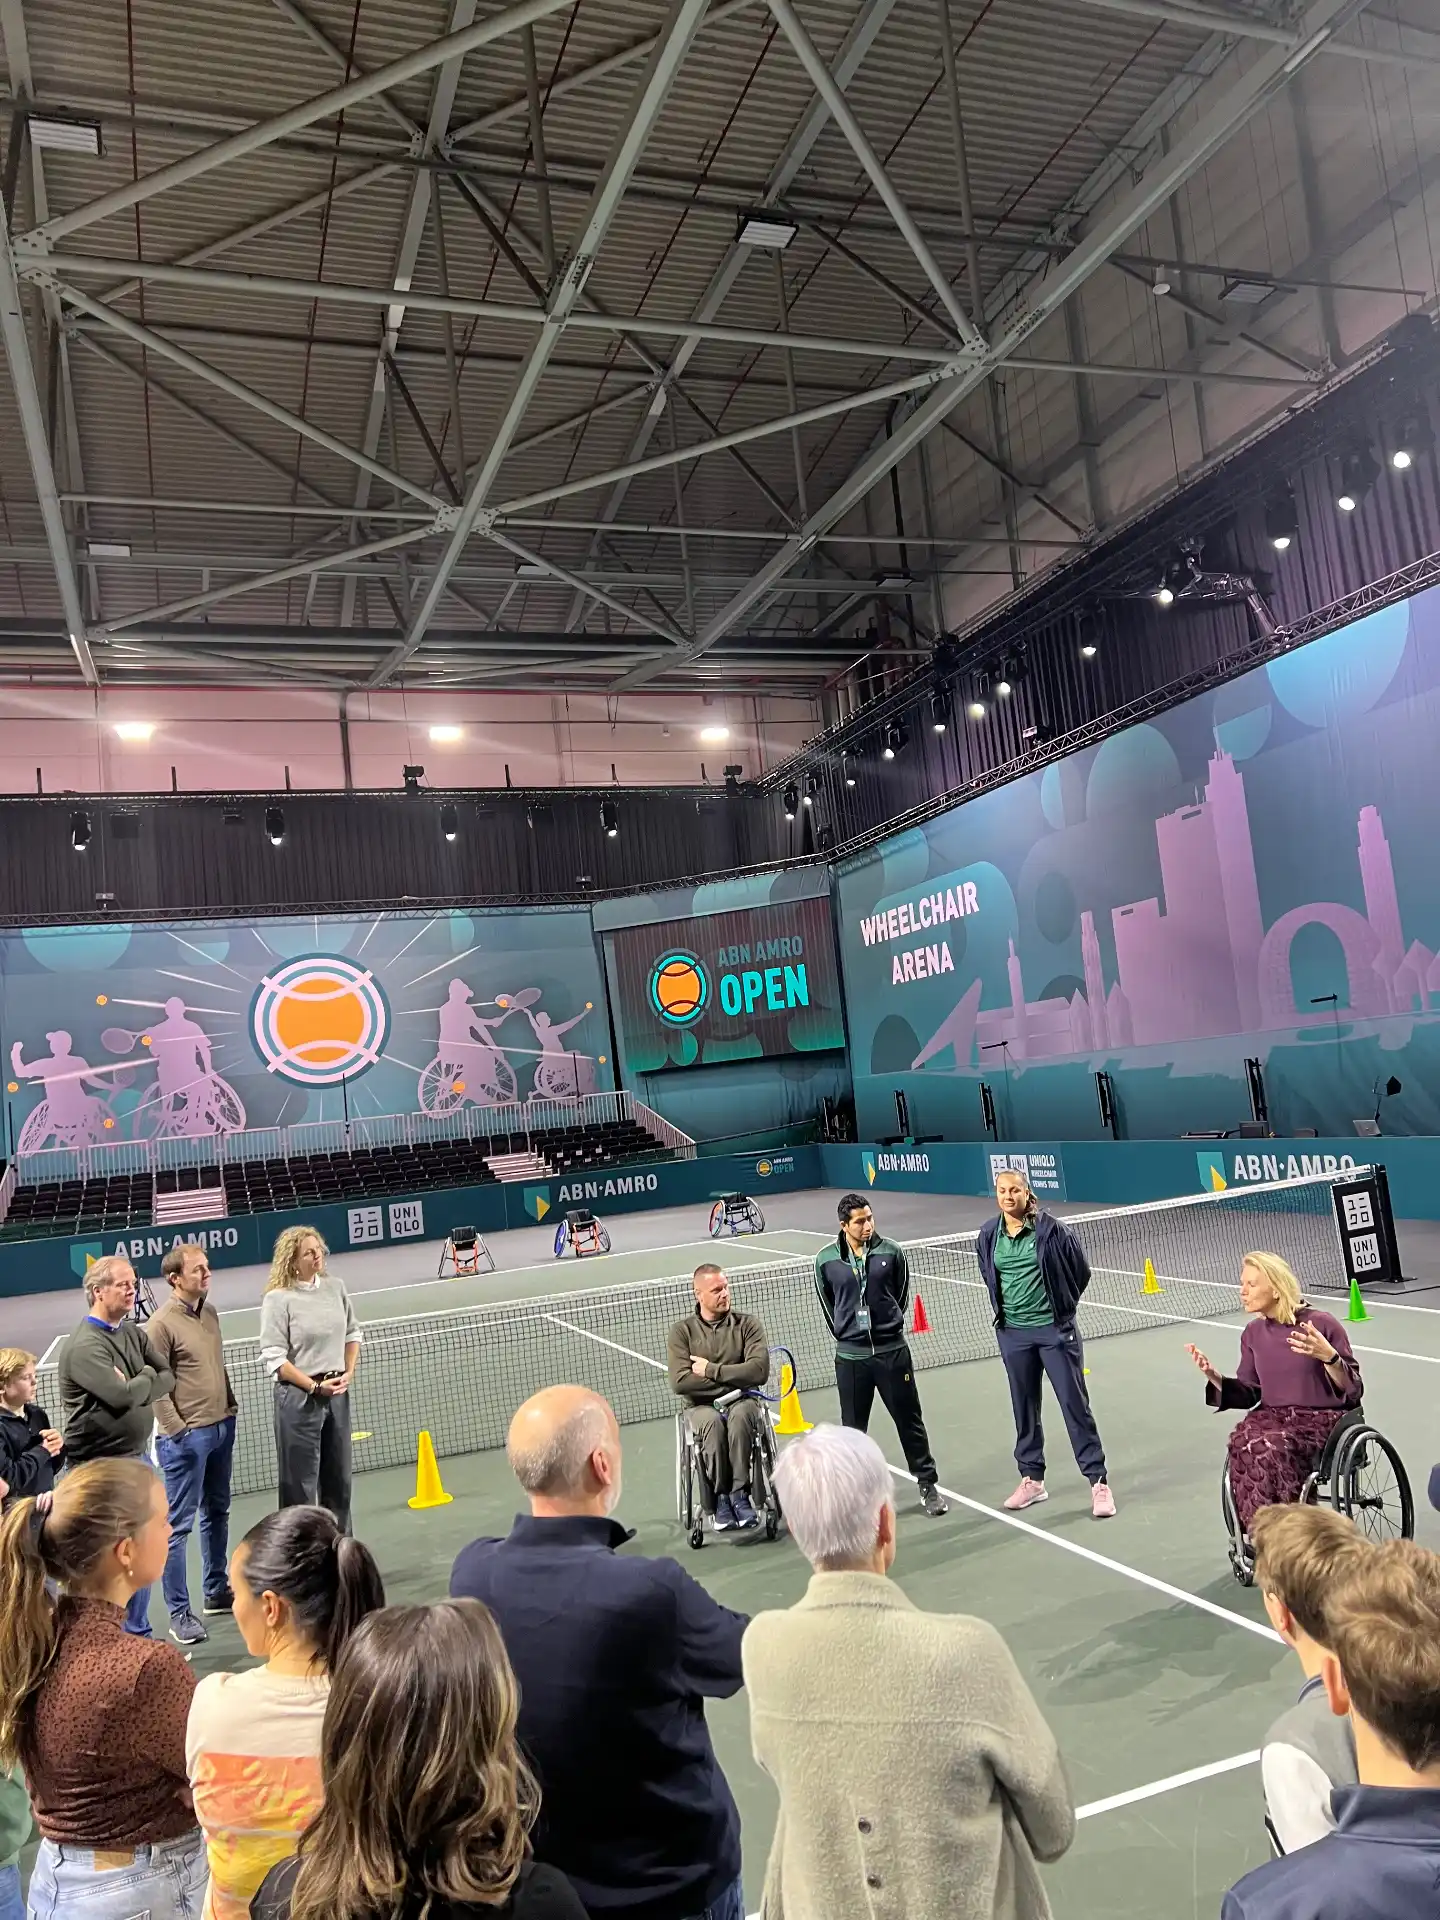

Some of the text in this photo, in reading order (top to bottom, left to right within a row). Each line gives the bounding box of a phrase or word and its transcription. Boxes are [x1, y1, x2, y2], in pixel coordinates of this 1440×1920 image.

[860, 881, 980, 947] WHEELCHAIR
[718, 935, 804, 968] ABN AMRO
[892, 941, 955, 985] ARENA
[720, 963, 810, 1017] OPEN
[774, 1162, 795, 1174] OPEN
[1029, 1154, 1056, 1167] UNIQLO
[393, 1206, 417, 1220] UNI
[394, 1220, 420, 1235] QLO
[1353, 1239, 1374, 1253] UNI
[1356, 1253, 1377, 1269] QLO
